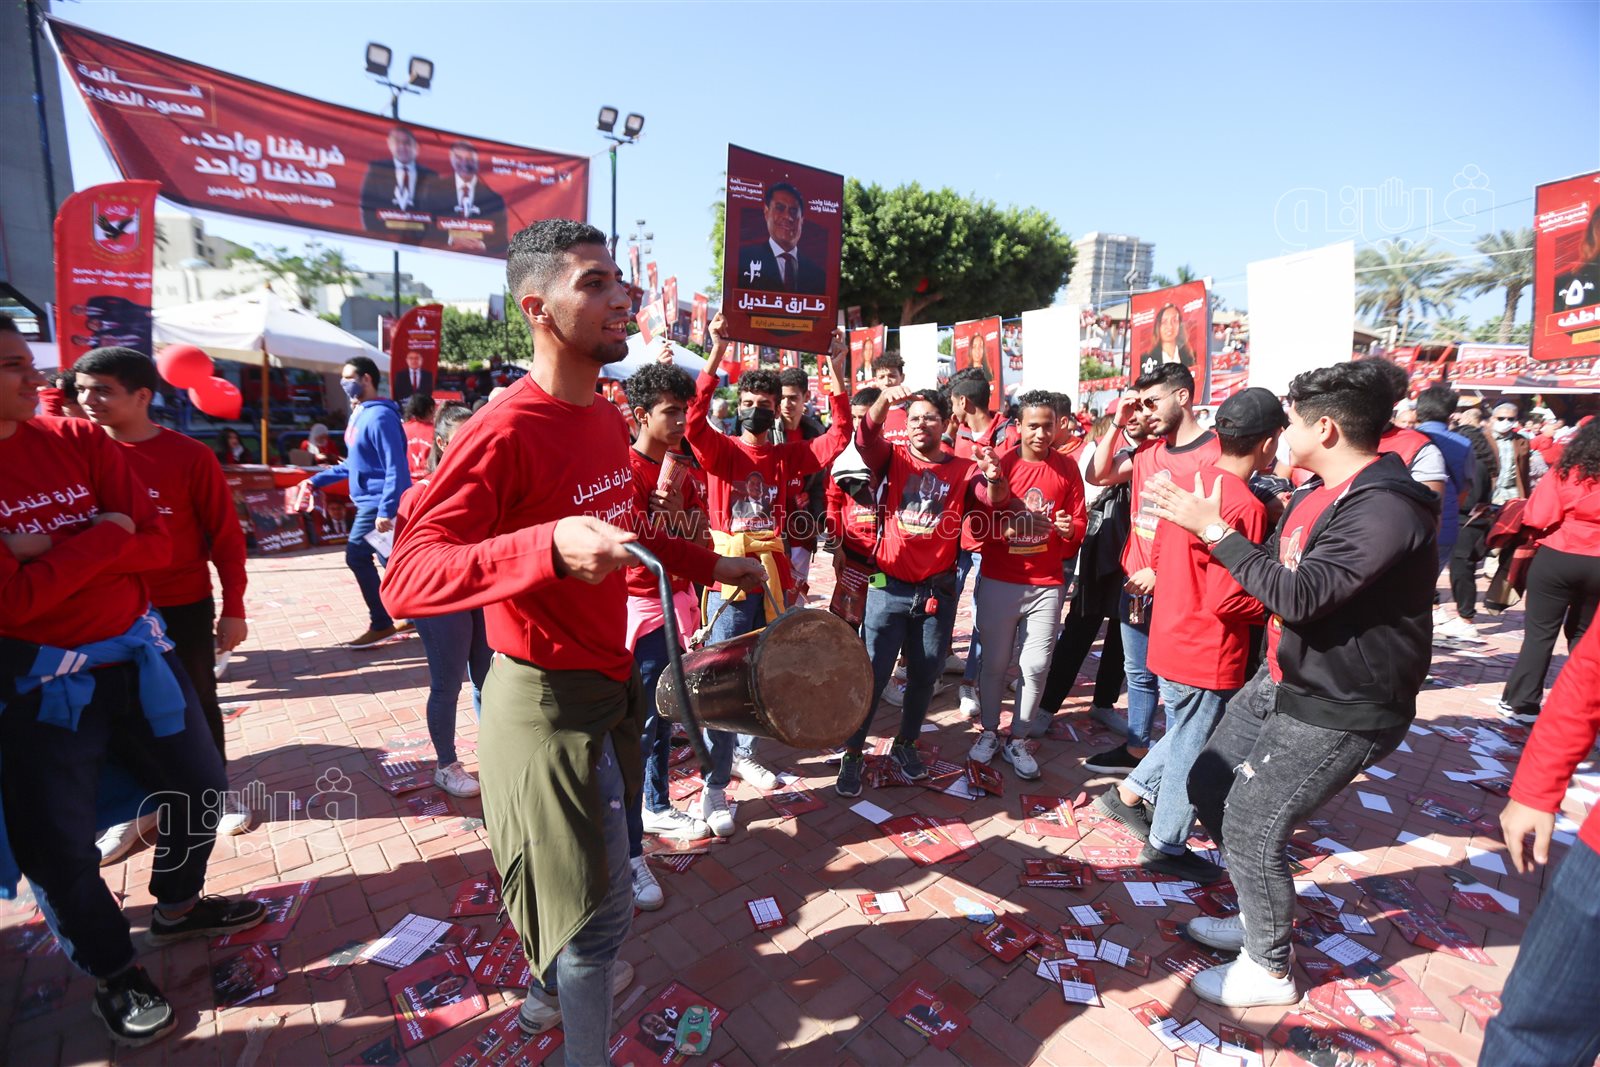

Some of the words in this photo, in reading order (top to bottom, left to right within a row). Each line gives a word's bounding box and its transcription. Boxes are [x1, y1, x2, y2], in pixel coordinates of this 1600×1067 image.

[79, 83, 144, 107] الخطيب
[147, 97, 205, 118] محمود
[180, 131, 262, 160] واحد..
[266, 135, 345, 168] فريقنا
[194, 156, 257, 184] واحد
[261, 159, 336, 188] هدفنا
[810, 205, 822, 213] واحد
[824, 200, 839, 208] فريقنا
[738, 293, 783, 310] قنديل
[1565, 279, 1584, 305] ٥
[785, 297, 825, 313] طارق
[612, 467, 632, 489] طارق
[573, 475, 611, 505] قنديل
[47, 513, 87, 530] مجلس
[603, 501, 626, 523] مجلس
[404, 986, 419, 1003] قنديل
[412, 1000, 427, 1017] طارق
